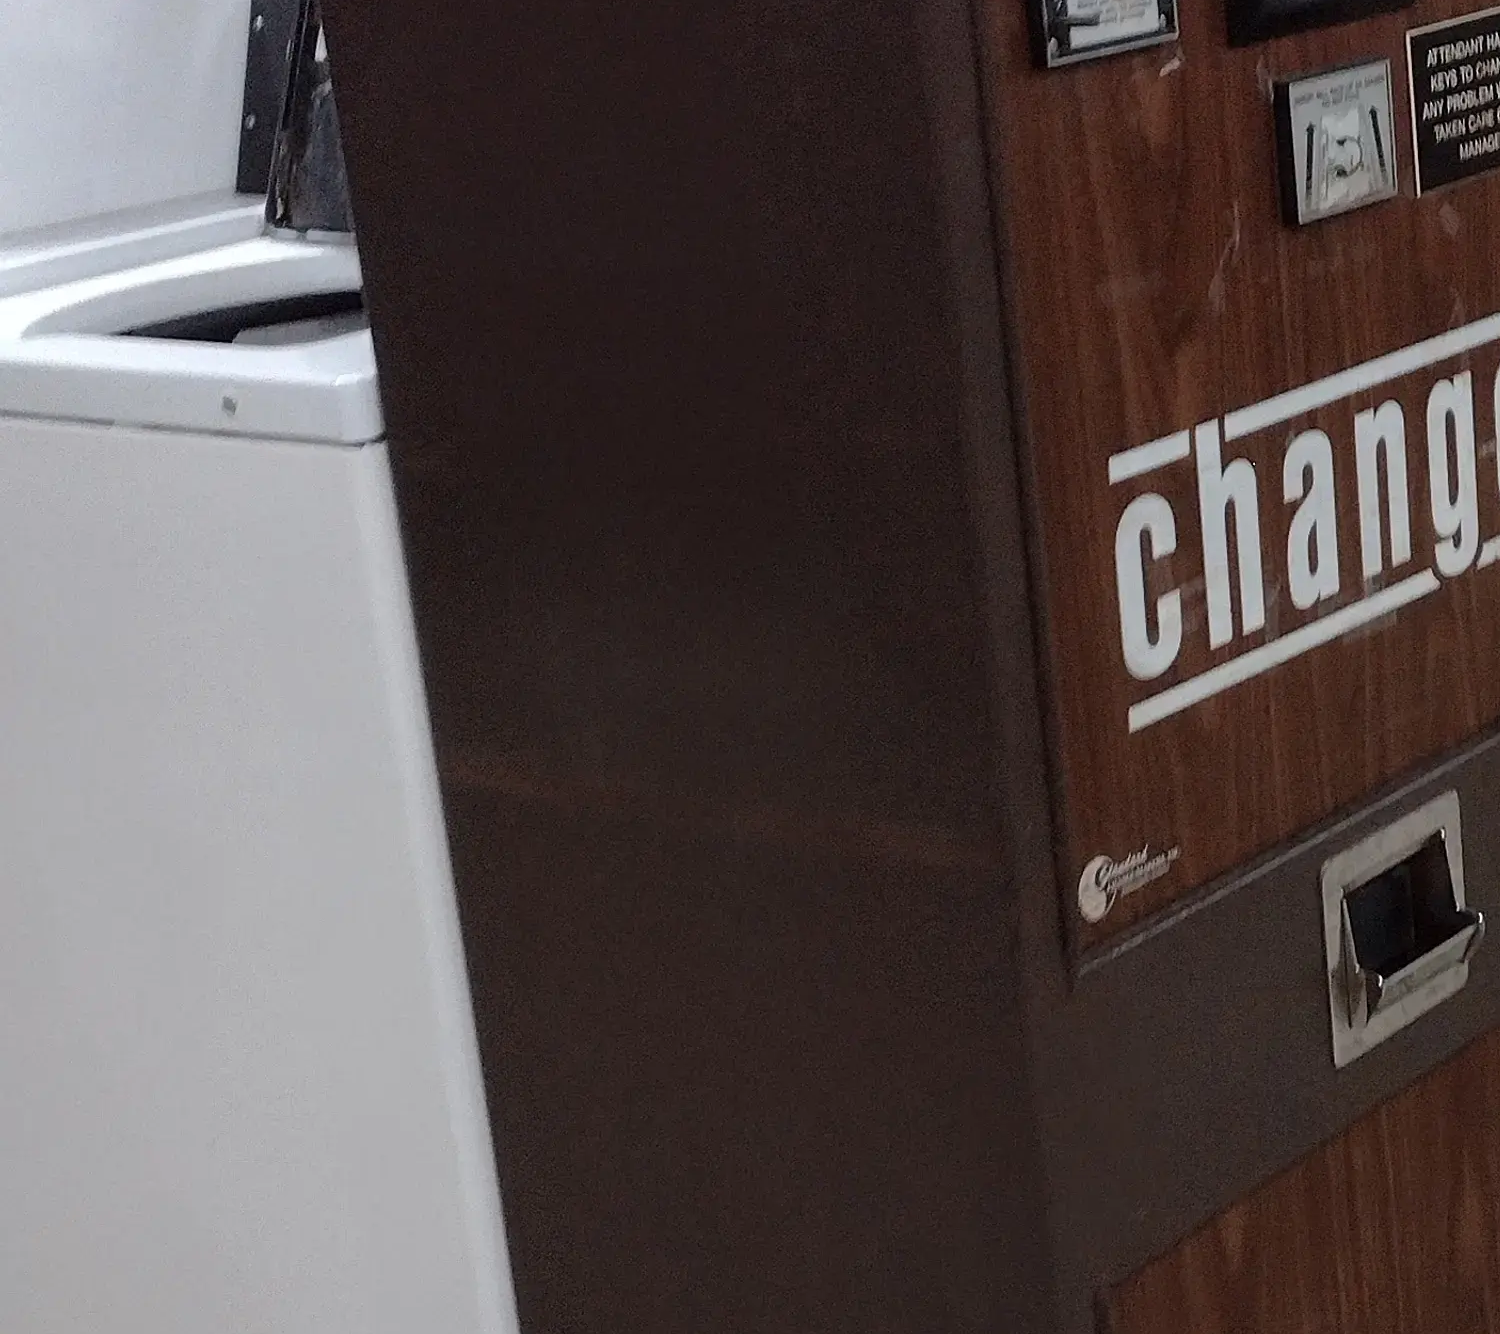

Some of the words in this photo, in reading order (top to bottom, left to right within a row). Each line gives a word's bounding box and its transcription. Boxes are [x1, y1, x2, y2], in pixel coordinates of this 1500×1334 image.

[1426, 34, 1485, 68] ATTENDANT
[1430, 68, 1458, 93] KEYS
[1459, 63, 1474, 85] TO
[1422, 98, 1445, 122] ANY
[1446, 83, 1495, 115] PROBLEM
[1433, 118, 1467, 145] TAKEN
[1467, 107, 1495, 135] CARE
